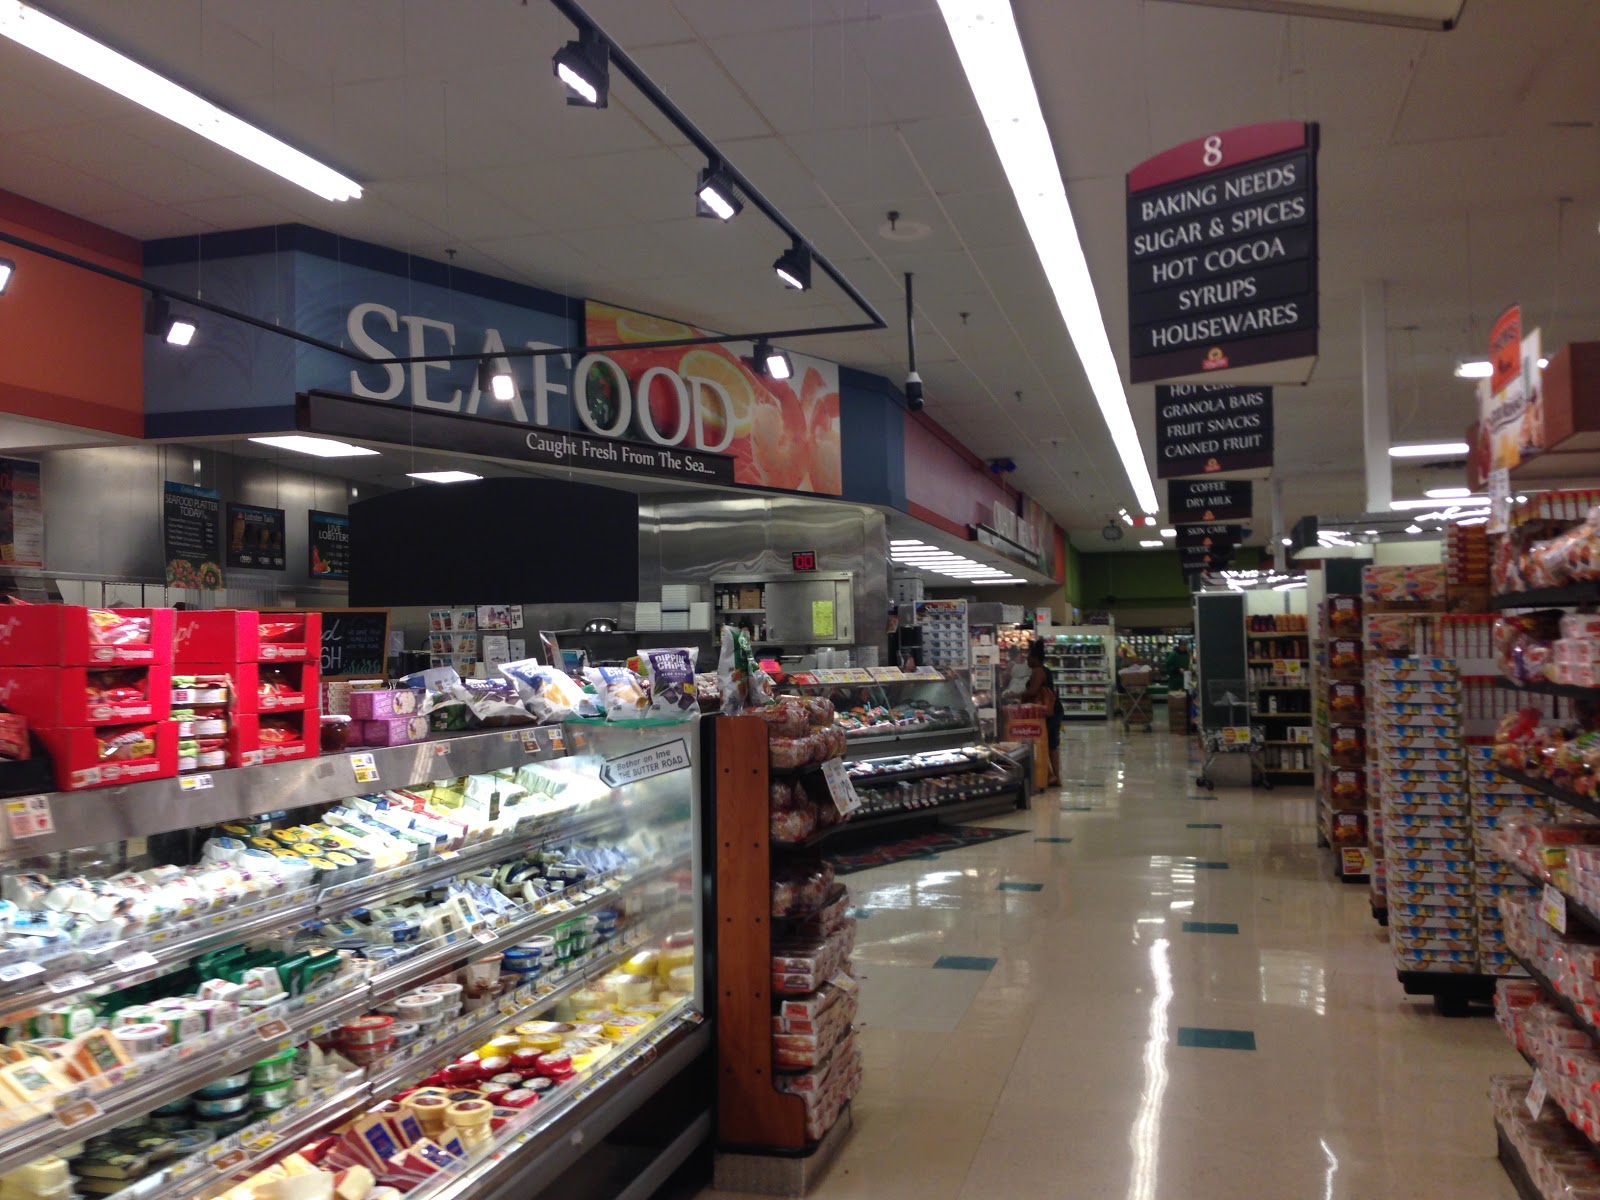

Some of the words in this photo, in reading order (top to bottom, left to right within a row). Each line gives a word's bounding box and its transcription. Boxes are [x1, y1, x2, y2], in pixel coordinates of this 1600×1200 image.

[1202, 135, 1222, 167] 8
[1141, 184, 1217, 222] BAKING
[1224, 163, 1297, 201] NEEDS
[1134, 221, 1202, 256] SUGAR
[1208, 217, 1225, 239] &
[1231, 197, 1306, 233] SPICES
[1152, 256, 1198, 283] HOT
[1204, 236, 1286, 273] COCOA
[1178, 276, 1257, 311] SYRUPS
[1152, 303, 1299, 348] HOUSEWARES
[346, 303, 735, 453] SEAFOOD
[1162, 398, 1226, 419] GRANOLA
[1229, 391, 1265, 409] BARS
[1166, 421, 1204, 438] FRUIT
[1207, 414, 1261, 434] SNACKS
[525, 432, 577, 459] Caught
[581, 440, 617, 461] Fresh
[621, 446, 655, 466] From
[658, 451, 682, 470] The
[1164, 439, 1219, 458] CANNED
[1223, 433, 1263, 451] FRUIT
[1190, 481, 1226, 493] COFFEE
[165, 493, 194, 507] SEAFOOD
[194, 498, 218, 512] PLATTER
[1186, 497, 1205, 508] DRY
[1208, 495, 1232, 505] MILK
[327, 524, 341, 533] LIVE
[657, 661, 687, 671] CHIPS
[618, 770, 632, 780] THE
[632, 762, 660, 776] BUTTER
[661, 755, 683, 769] ROAD
